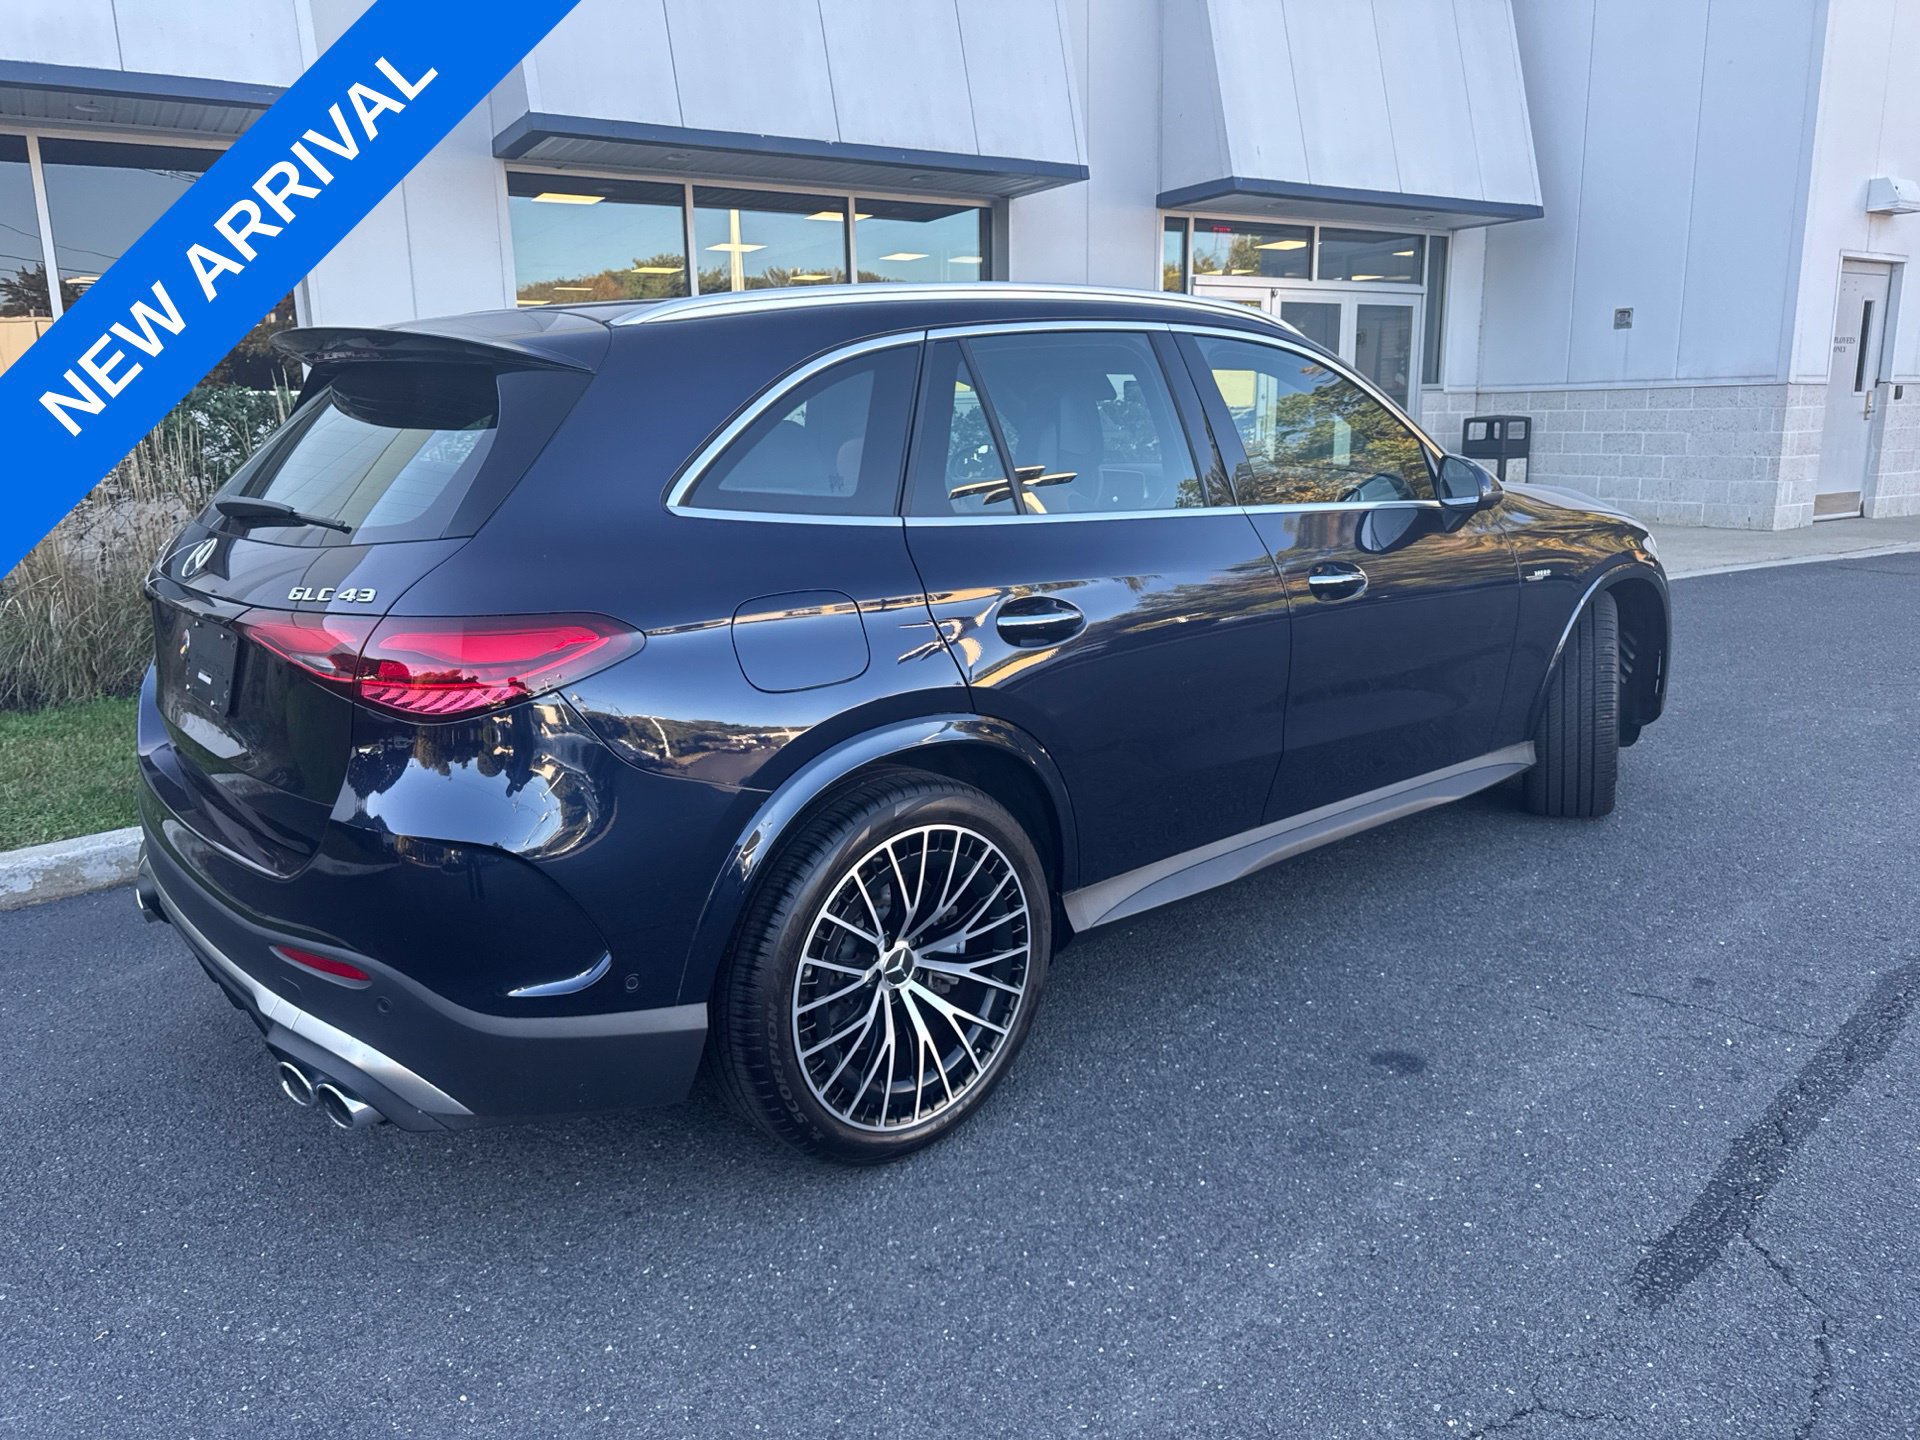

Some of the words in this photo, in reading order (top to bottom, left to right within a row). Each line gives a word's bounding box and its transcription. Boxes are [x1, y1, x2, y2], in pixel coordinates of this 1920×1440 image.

[287, 587, 336, 602] GLC
[337, 588, 377, 602] 43
[768, 1002, 809, 1124] SCORPION
